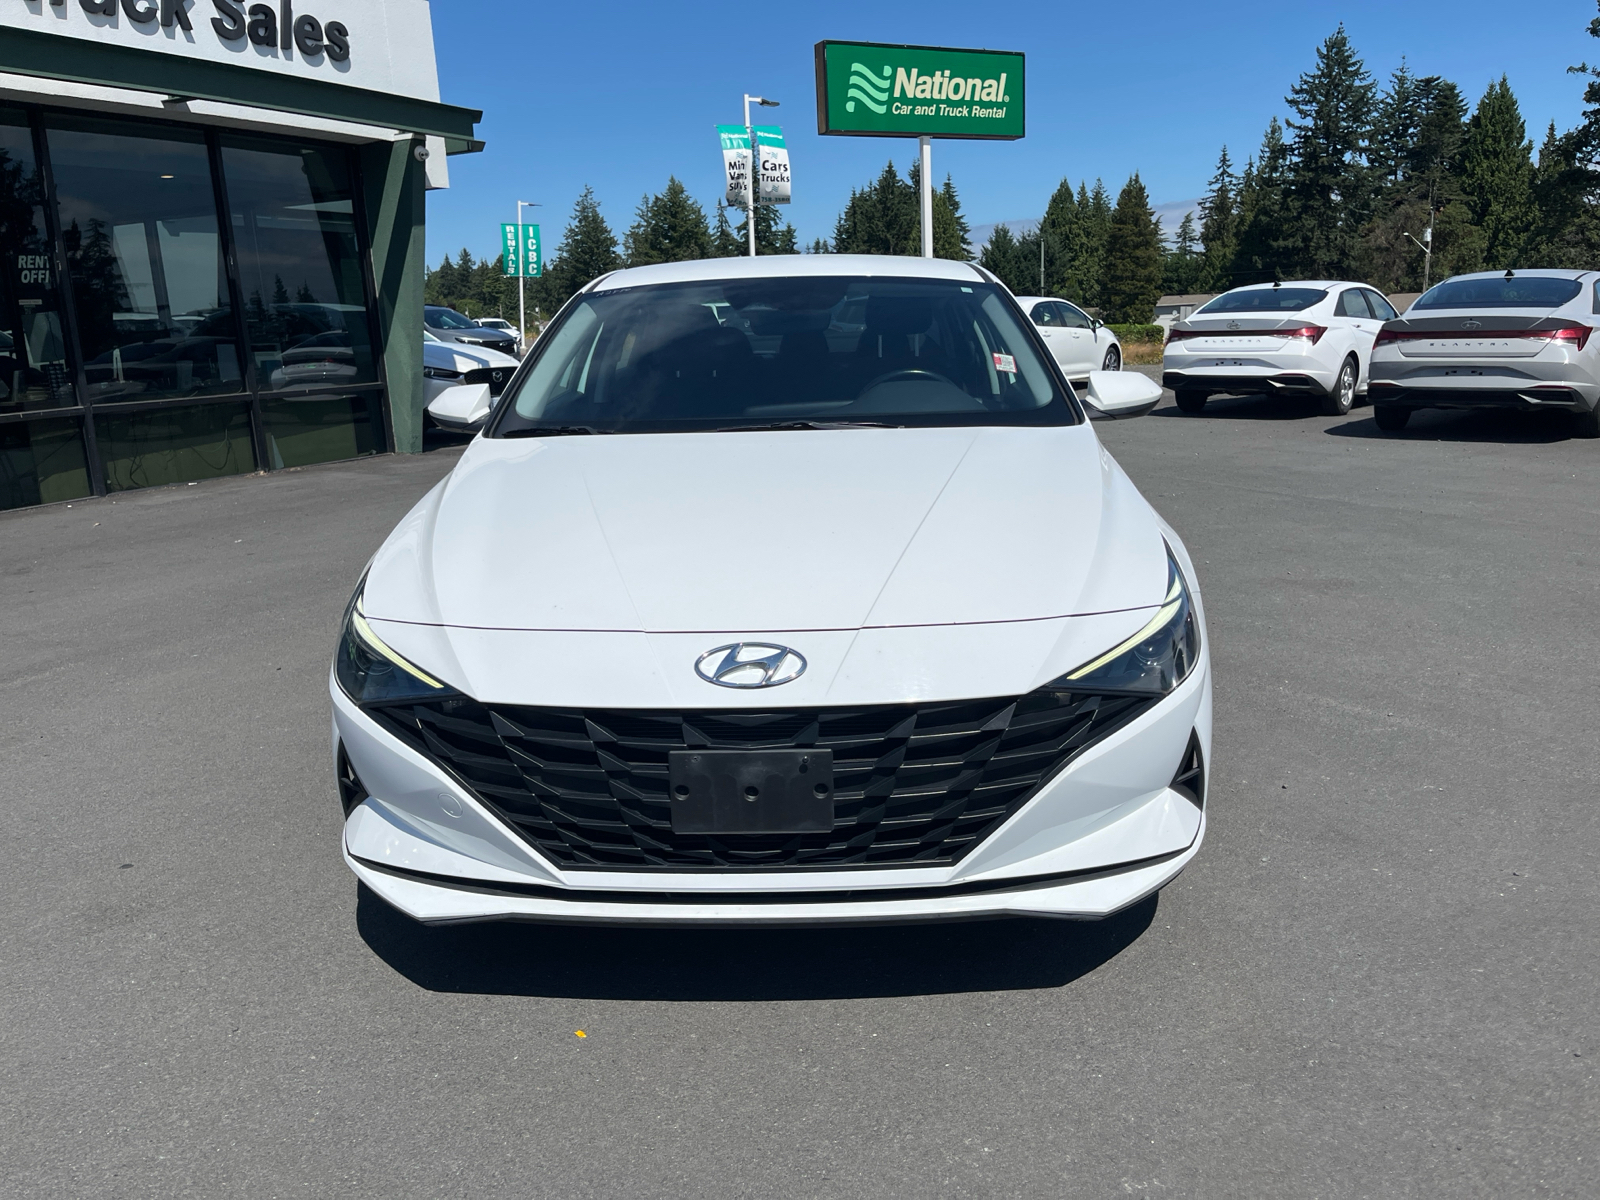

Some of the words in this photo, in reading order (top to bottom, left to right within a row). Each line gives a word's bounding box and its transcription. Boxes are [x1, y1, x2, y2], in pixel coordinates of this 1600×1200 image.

[210, 0, 350, 62] Sales
[893, 67, 1006, 102] National
[892, 102, 913, 115] Car
[914, 104, 937, 116] and
[939, 104, 969, 117] Truck
[971, 105, 1007, 118] Rental
[729, 171, 747, 180] Vans
[761, 174, 790, 182] Trucks
[762, 160, 788, 172] Cars
[506, 226, 515, 274] RENTALS
[528, 226, 537, 275] ICBC
